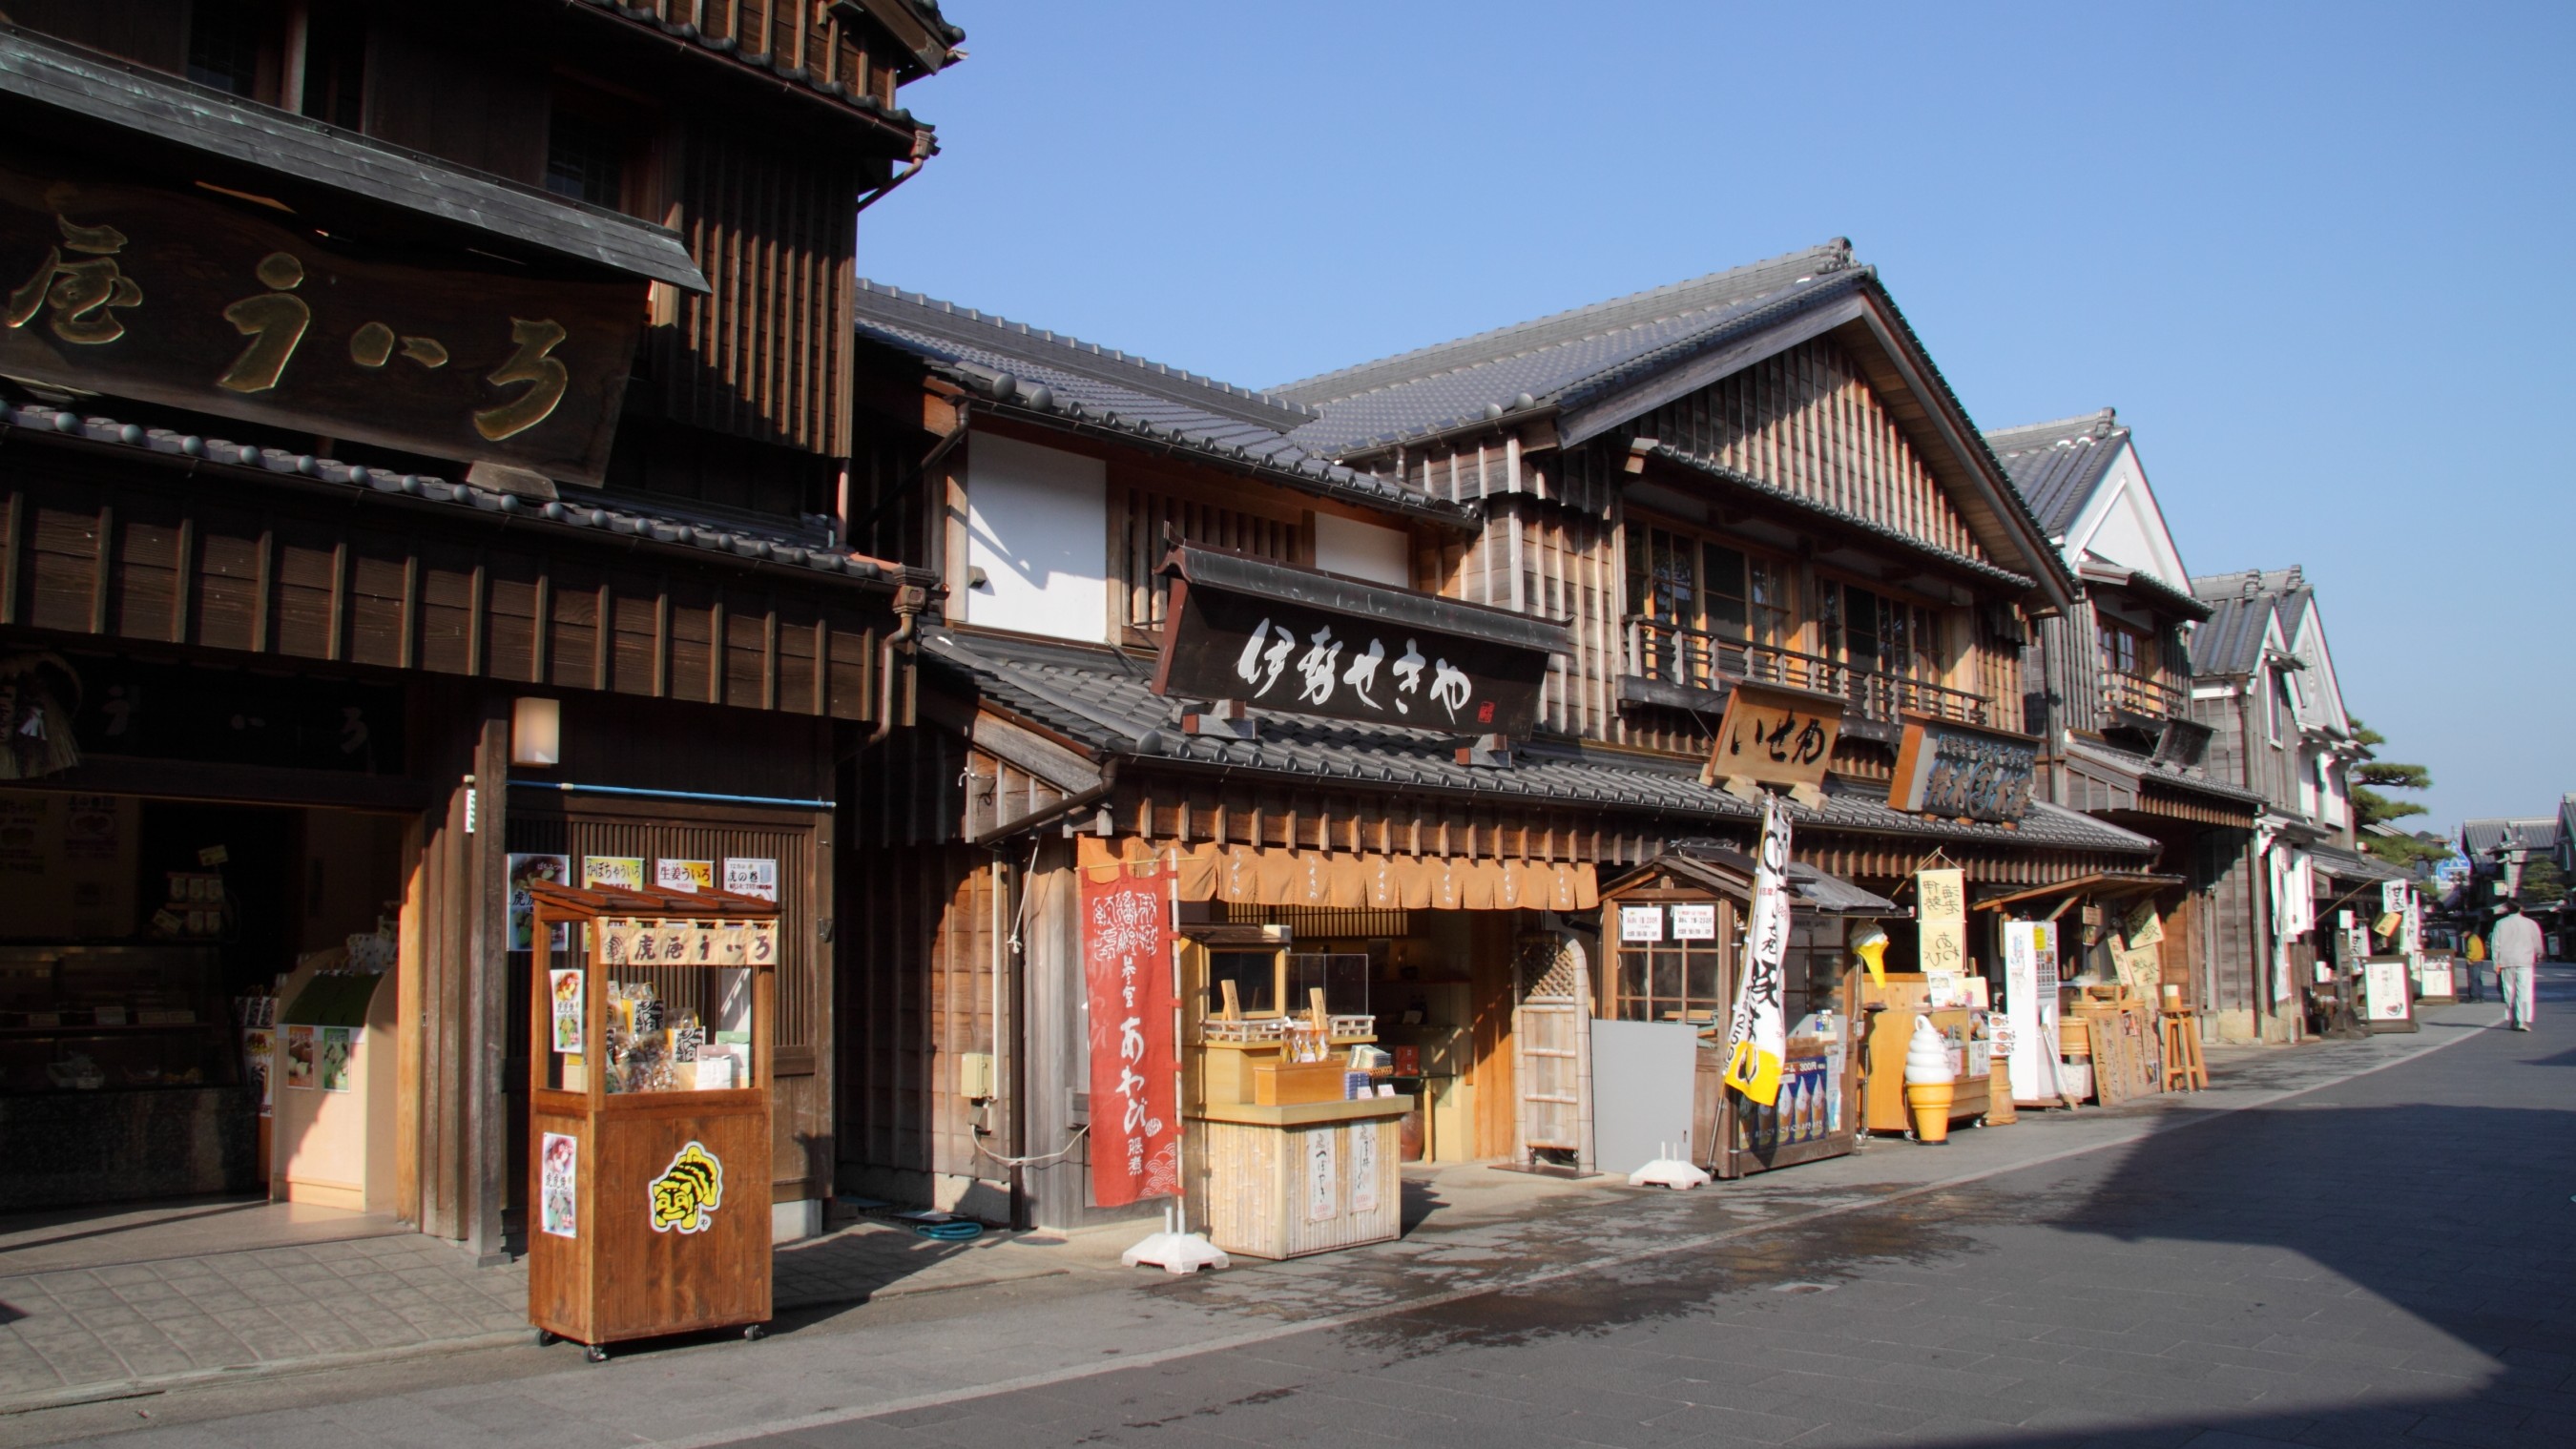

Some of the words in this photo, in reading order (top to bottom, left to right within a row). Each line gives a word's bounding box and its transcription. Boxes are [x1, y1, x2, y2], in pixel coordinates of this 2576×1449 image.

[587, 861, 640, 879] かぼちゃういろ
[660, 866, 710, 881] 生姜ういろ
[634, 934, 770, 961] 虎屋ういろ
